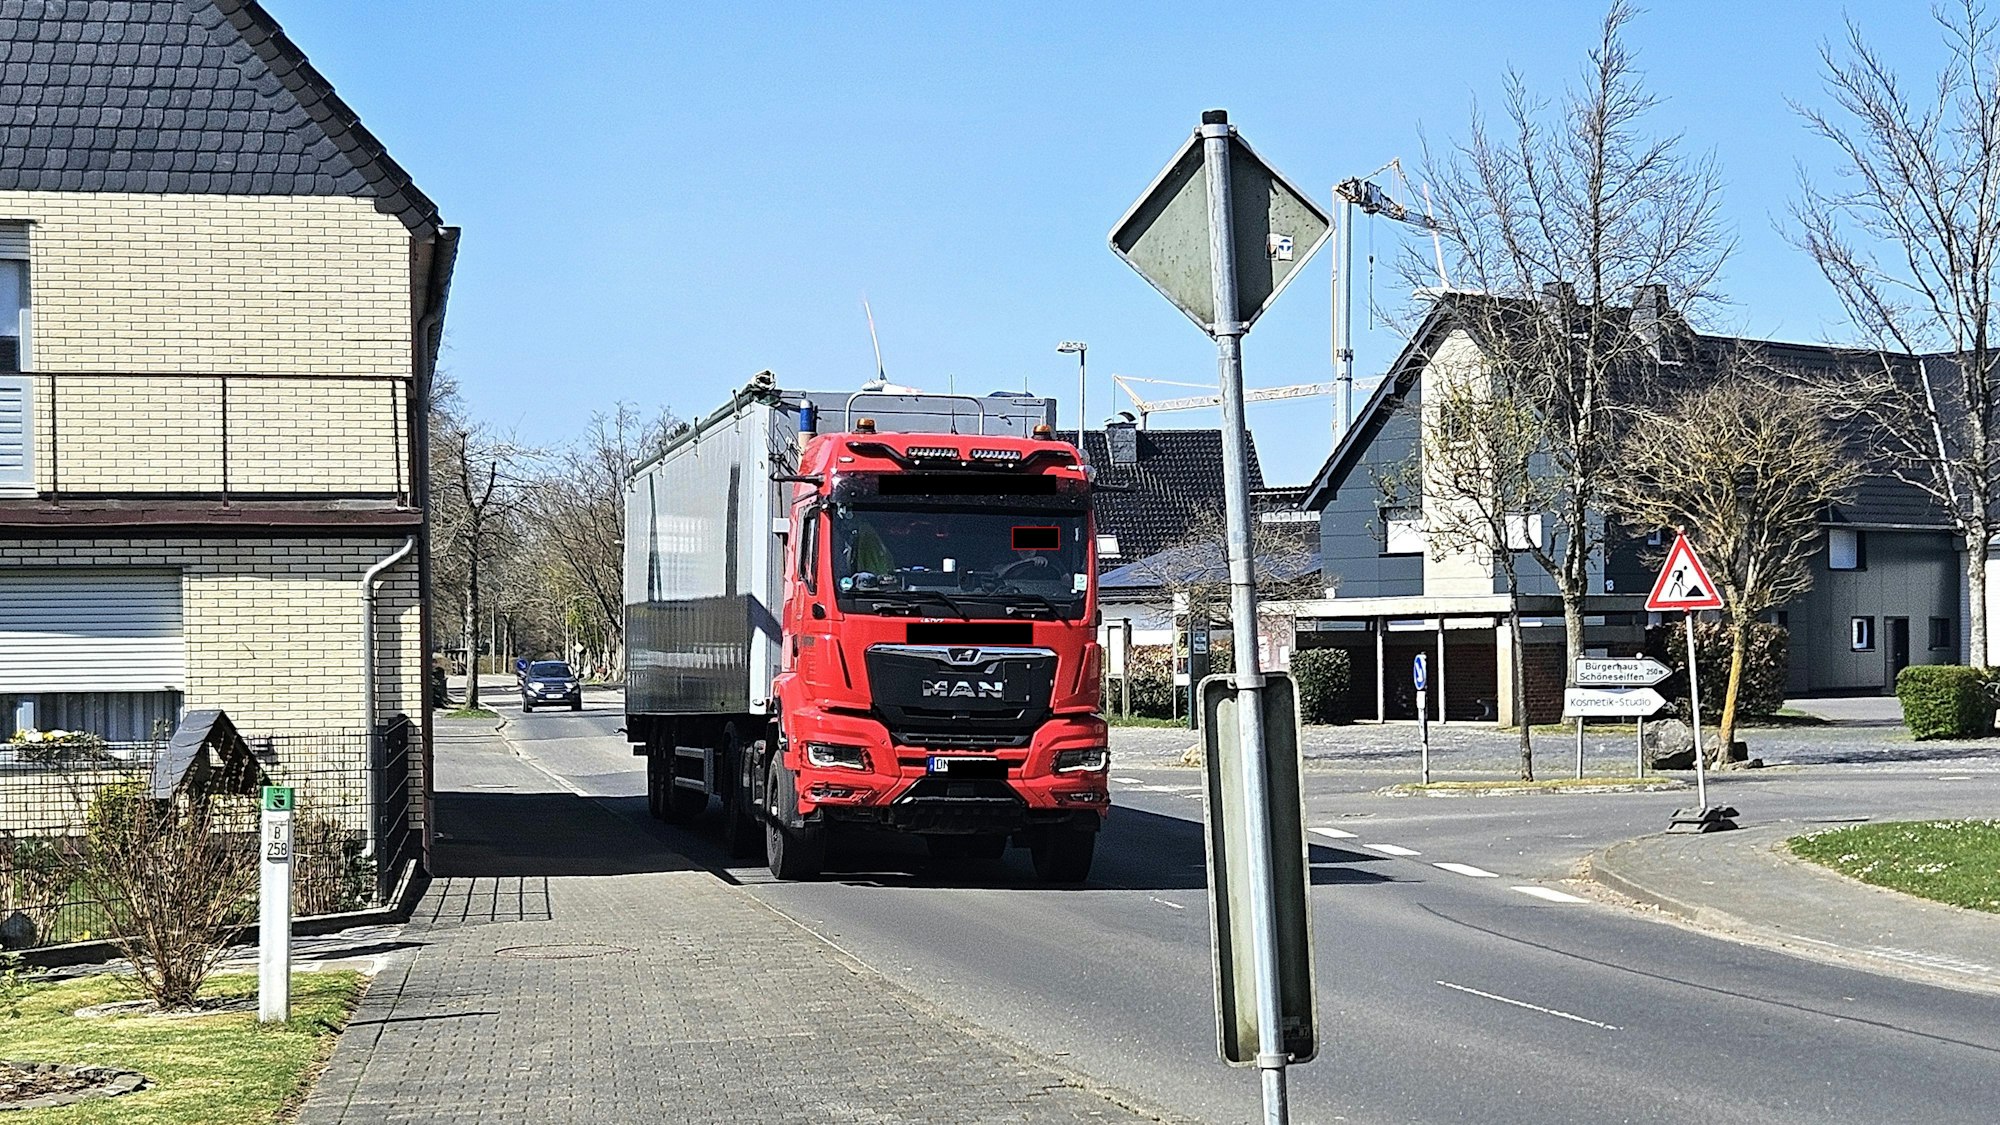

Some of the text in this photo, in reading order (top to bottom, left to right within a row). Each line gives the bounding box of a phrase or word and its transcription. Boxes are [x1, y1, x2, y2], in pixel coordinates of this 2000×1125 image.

[1585, 662, 1638, 672] Bürgerhaus
[1580, 672, 1644, 680] Schöneseiffen
[922, 679, 1003, 698] MAN
[1570, 698, 1652, 707] Kosmetik-Studio
[274, 826, 280, 840] B
[268, 842, 287, 856] 258
